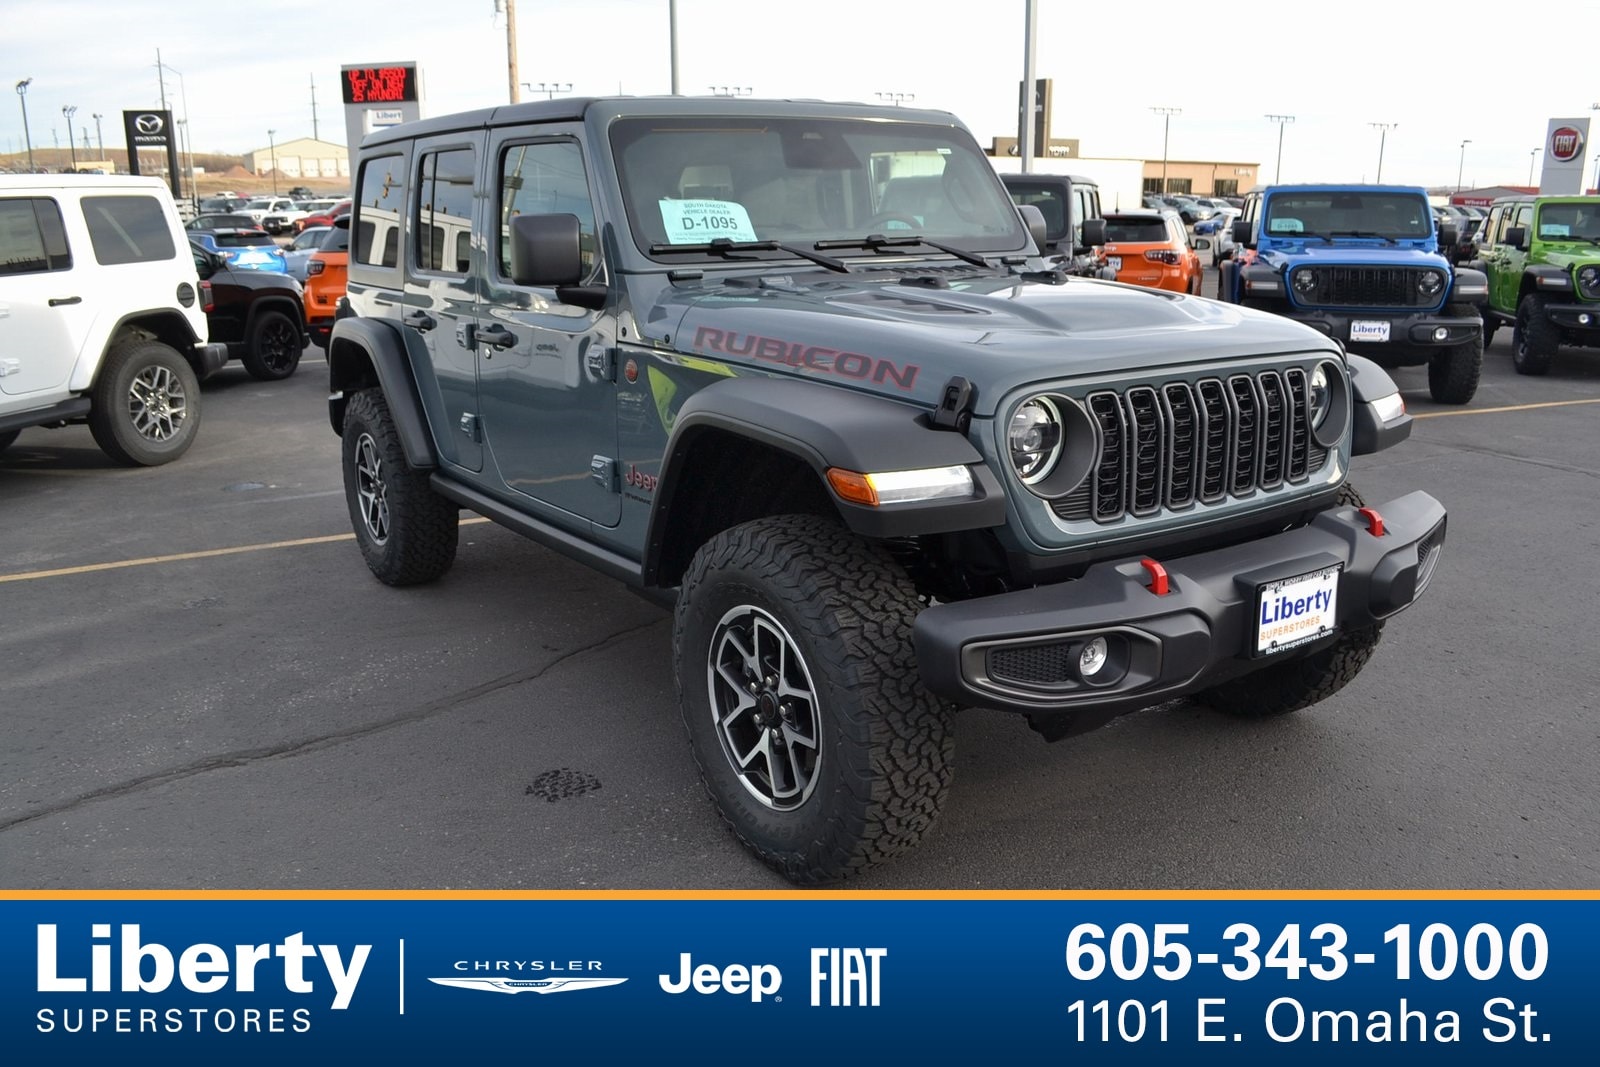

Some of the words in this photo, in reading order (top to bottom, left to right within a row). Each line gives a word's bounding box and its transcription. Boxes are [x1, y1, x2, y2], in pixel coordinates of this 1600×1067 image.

[348, 69, 360, 80] UP
[364, 68, 375, 80] TO
[352, 80, 368, 90] OFF
[372, 80, 382, 89] ON
[387, 78, 404, 89] NEW
[353, 90, 364, 102] 25
[368, 88, 404, 101] HYUNDAI
[1554, 135, 1576, 152] FIAT
[681, 216, 738, 230] D-1095
[1353, 325, 1388, 335] Liberty
[693, 326, 920, 391] RUBICON
[1262, 589, 1332, 625] Liberty
[1260, 615, 1320, 641] SUPERSTORES
[1266, 629, 1333, 655] libertysuperstores.com
